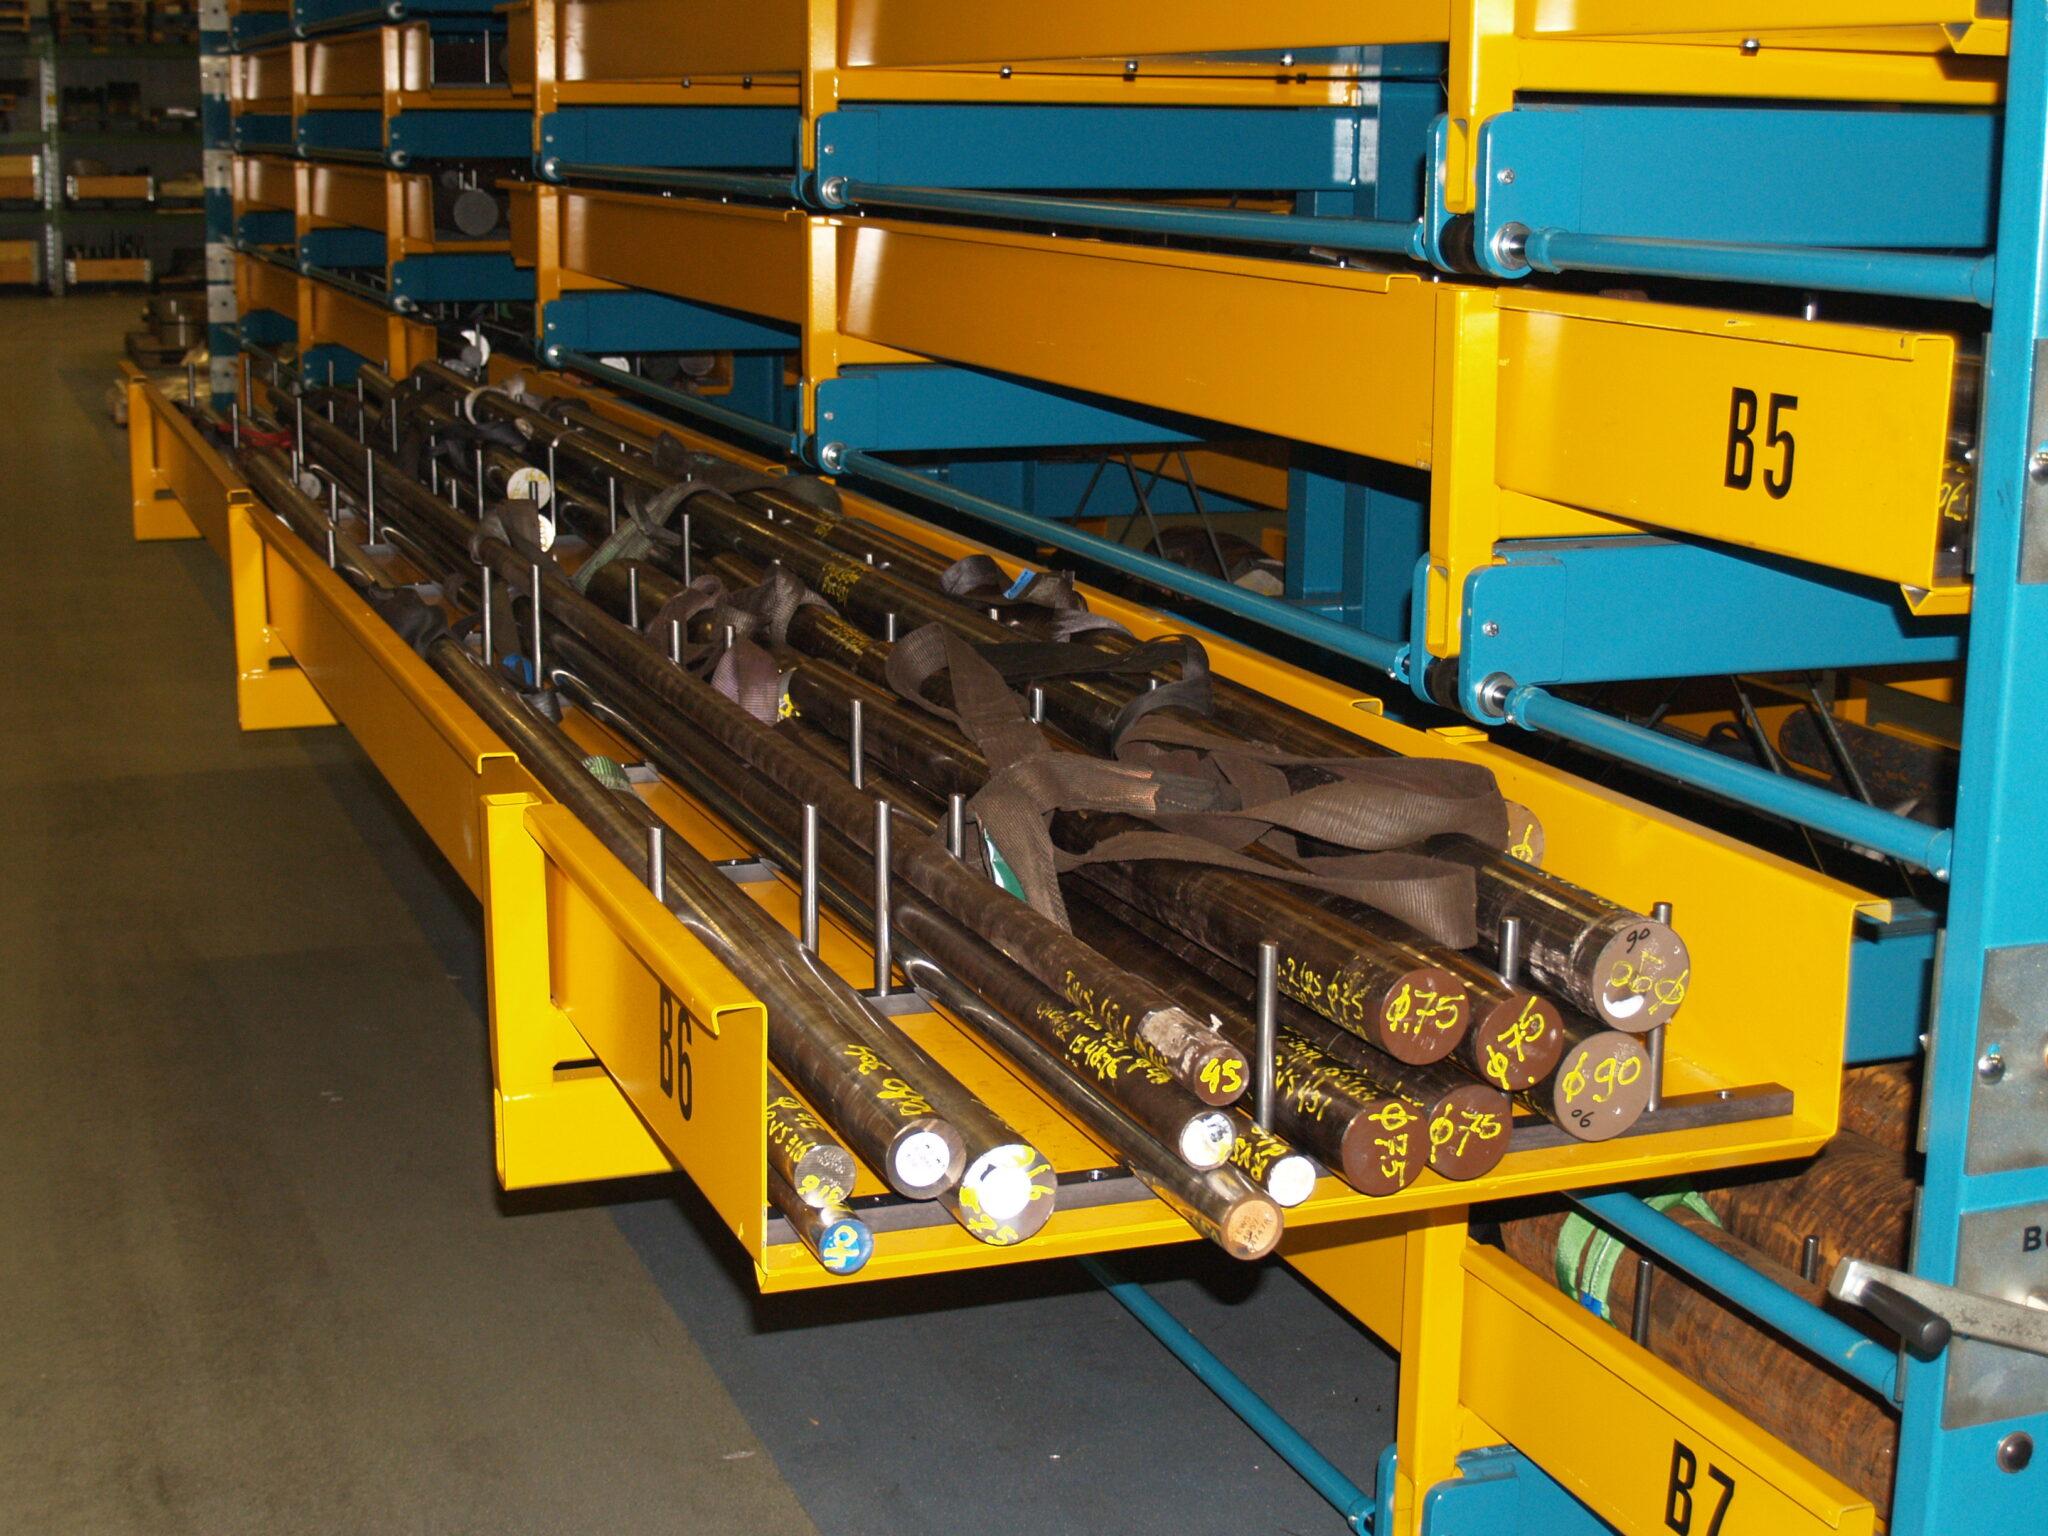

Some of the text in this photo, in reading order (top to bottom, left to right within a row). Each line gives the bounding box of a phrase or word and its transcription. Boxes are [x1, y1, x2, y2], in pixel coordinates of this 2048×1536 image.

[1723, 386, 1798, 499] B5
[660, 983, 692, 1121] B6
[1199, 1058, 1243, 1094] 45
[2022, 1225, 2048, 1252] B
[1663, 1437, 1736, 1536] B7
